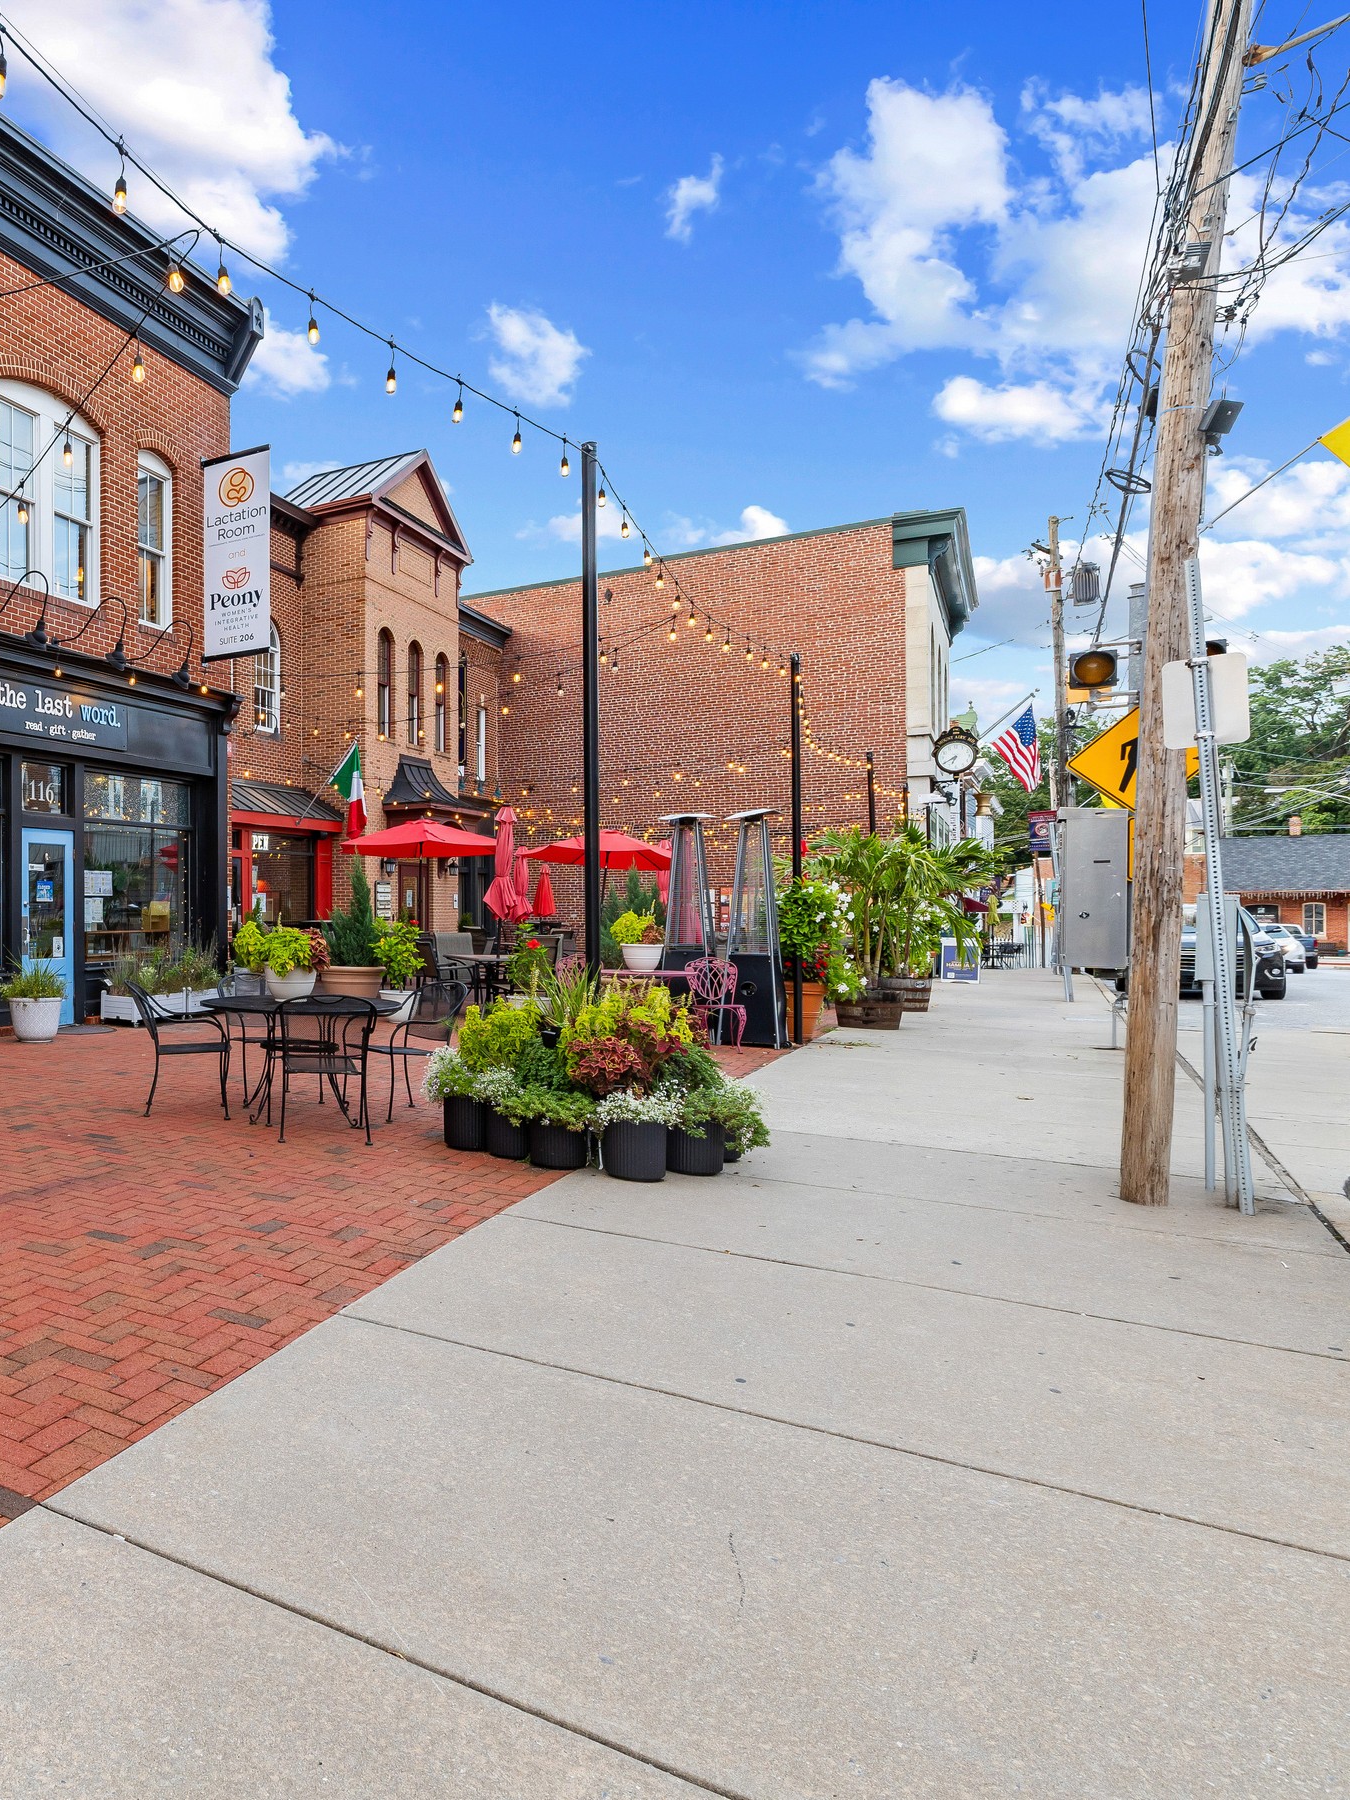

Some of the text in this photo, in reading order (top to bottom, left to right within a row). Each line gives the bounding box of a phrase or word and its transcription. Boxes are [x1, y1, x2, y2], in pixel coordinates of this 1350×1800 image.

[206, 506, 267, 528] Lactation
[217, 524, 255, 541] Room
[228, 548, 246, 560] and
[209, 588, 264, 611] Peony
[214, 614, 259, 626] INTEGRATIVE
[221, 608, 252, 618] WOMEN'S
[223, 623, 250, 632] HEALTH
[219, 633, 255, 646] SUITE 206
[34, 689, 73, 718] last
[80, 703, 121, 728] word.
[24, 720, 97, 741] read gift gather
[29, 779, 55, 804] 116
[251, 834, 269, 851] PEN
